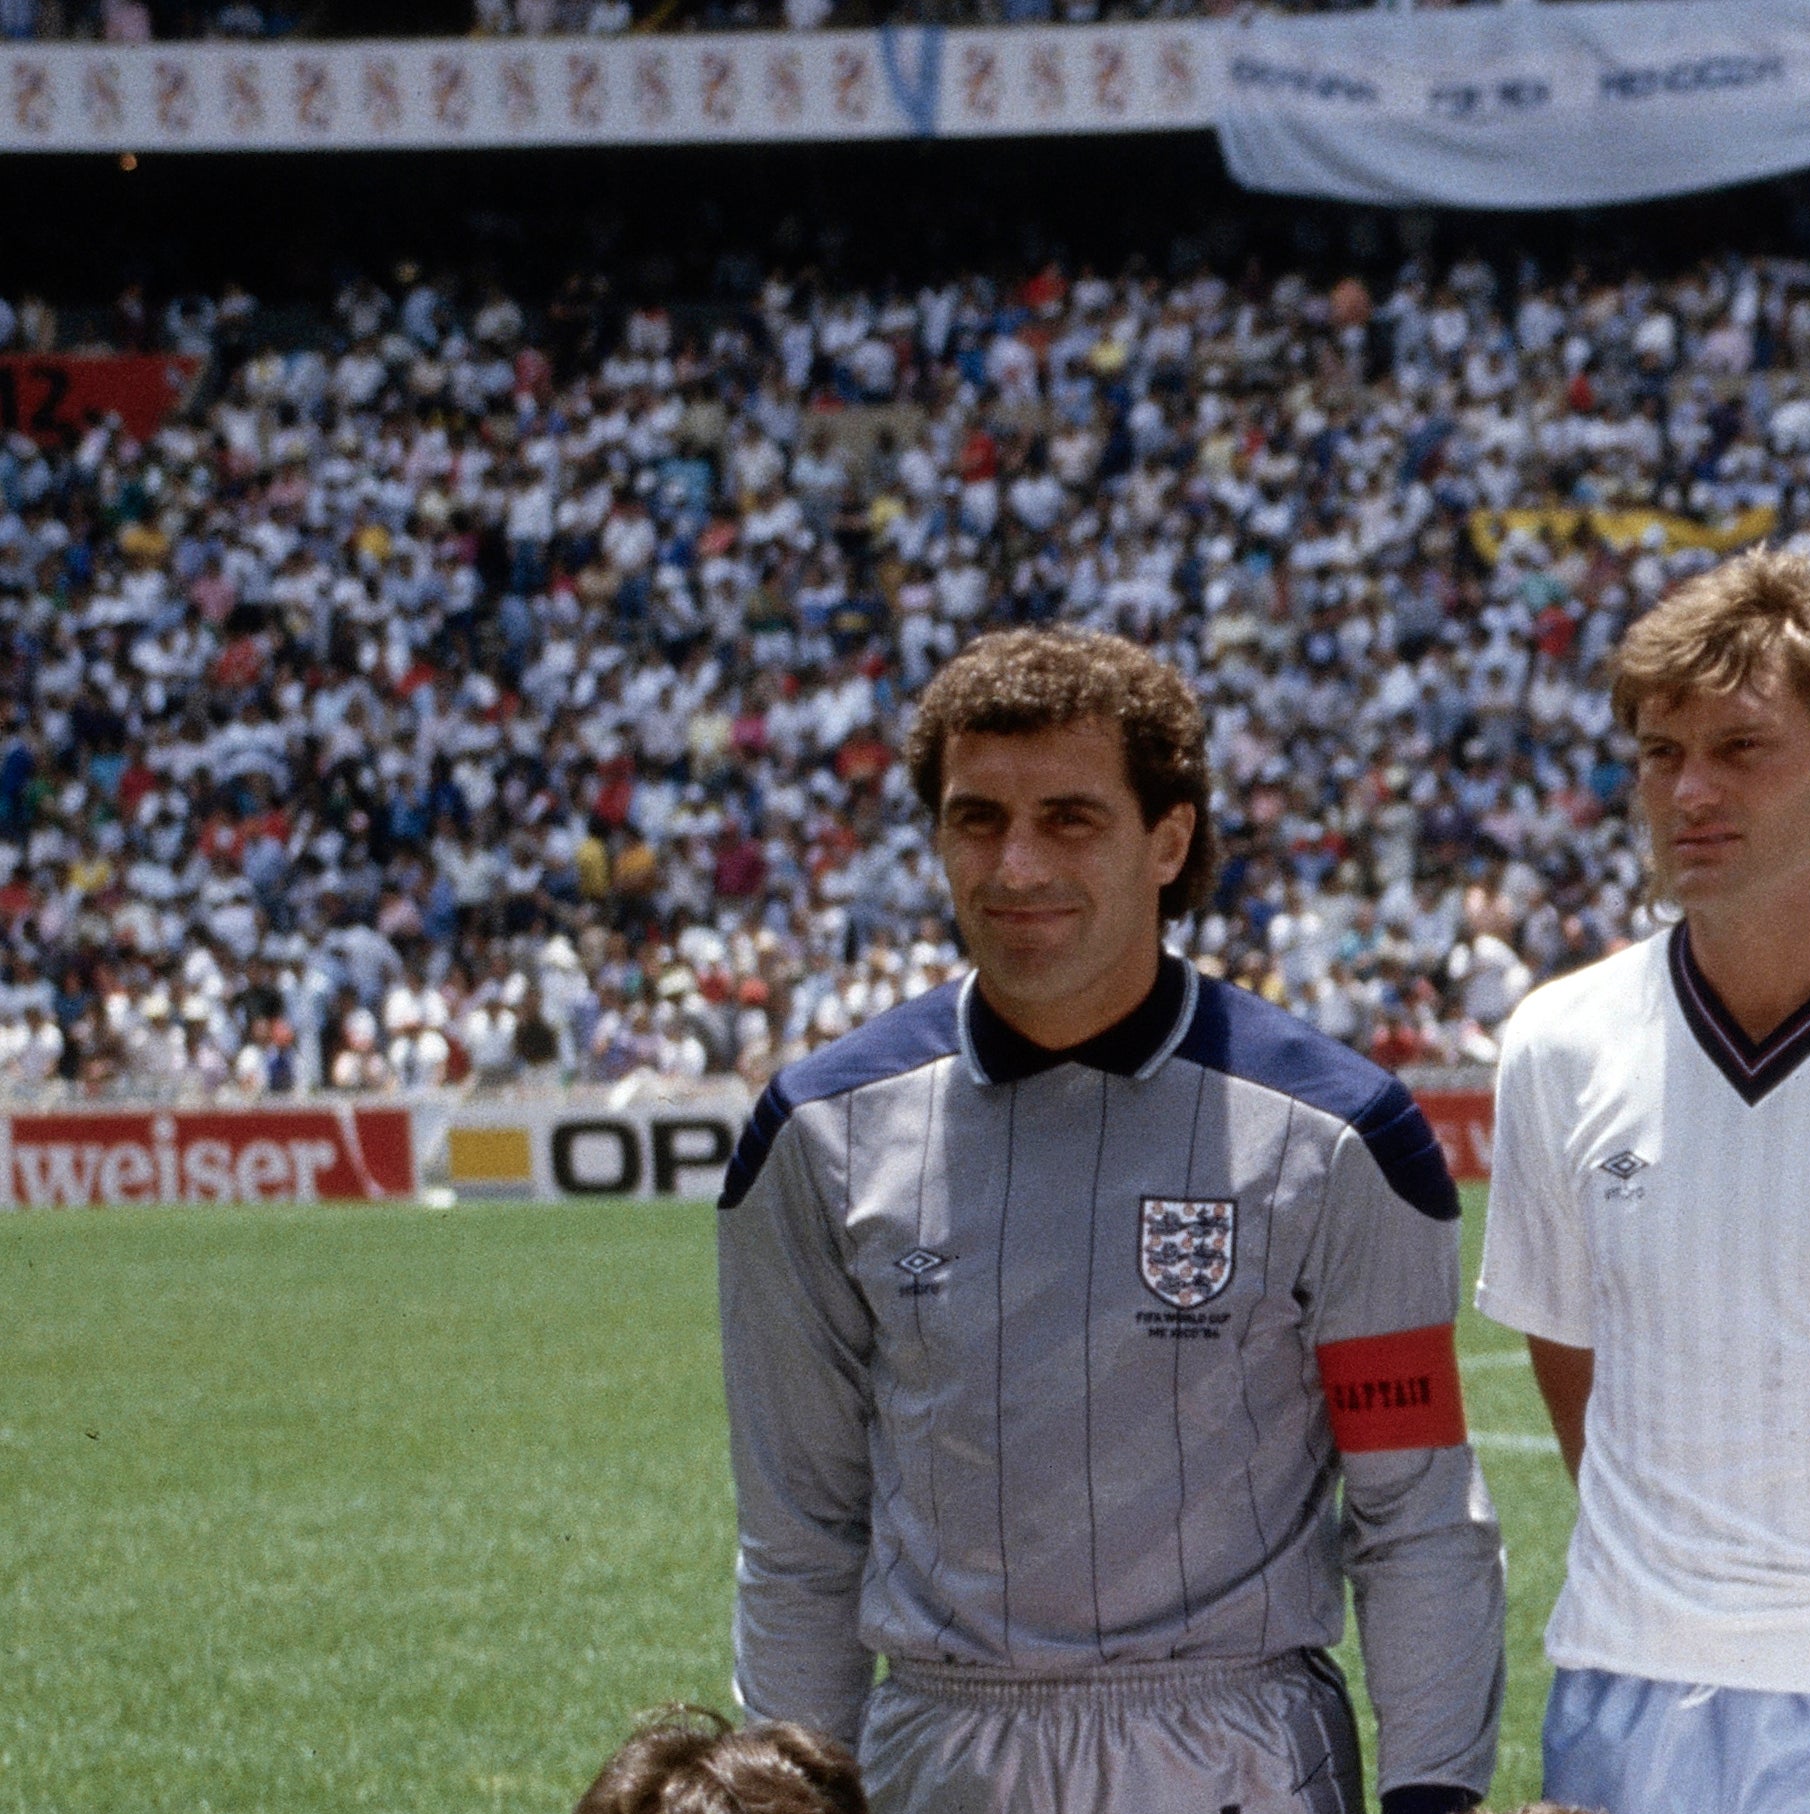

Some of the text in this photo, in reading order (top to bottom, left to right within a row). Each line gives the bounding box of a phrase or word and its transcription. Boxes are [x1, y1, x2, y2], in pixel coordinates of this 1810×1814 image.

[8, 1108, 338, 1204] weiser
[551, 1117, 735, 1196] OP
[1333, 1376, 1431, 1411] CAPTAIN
